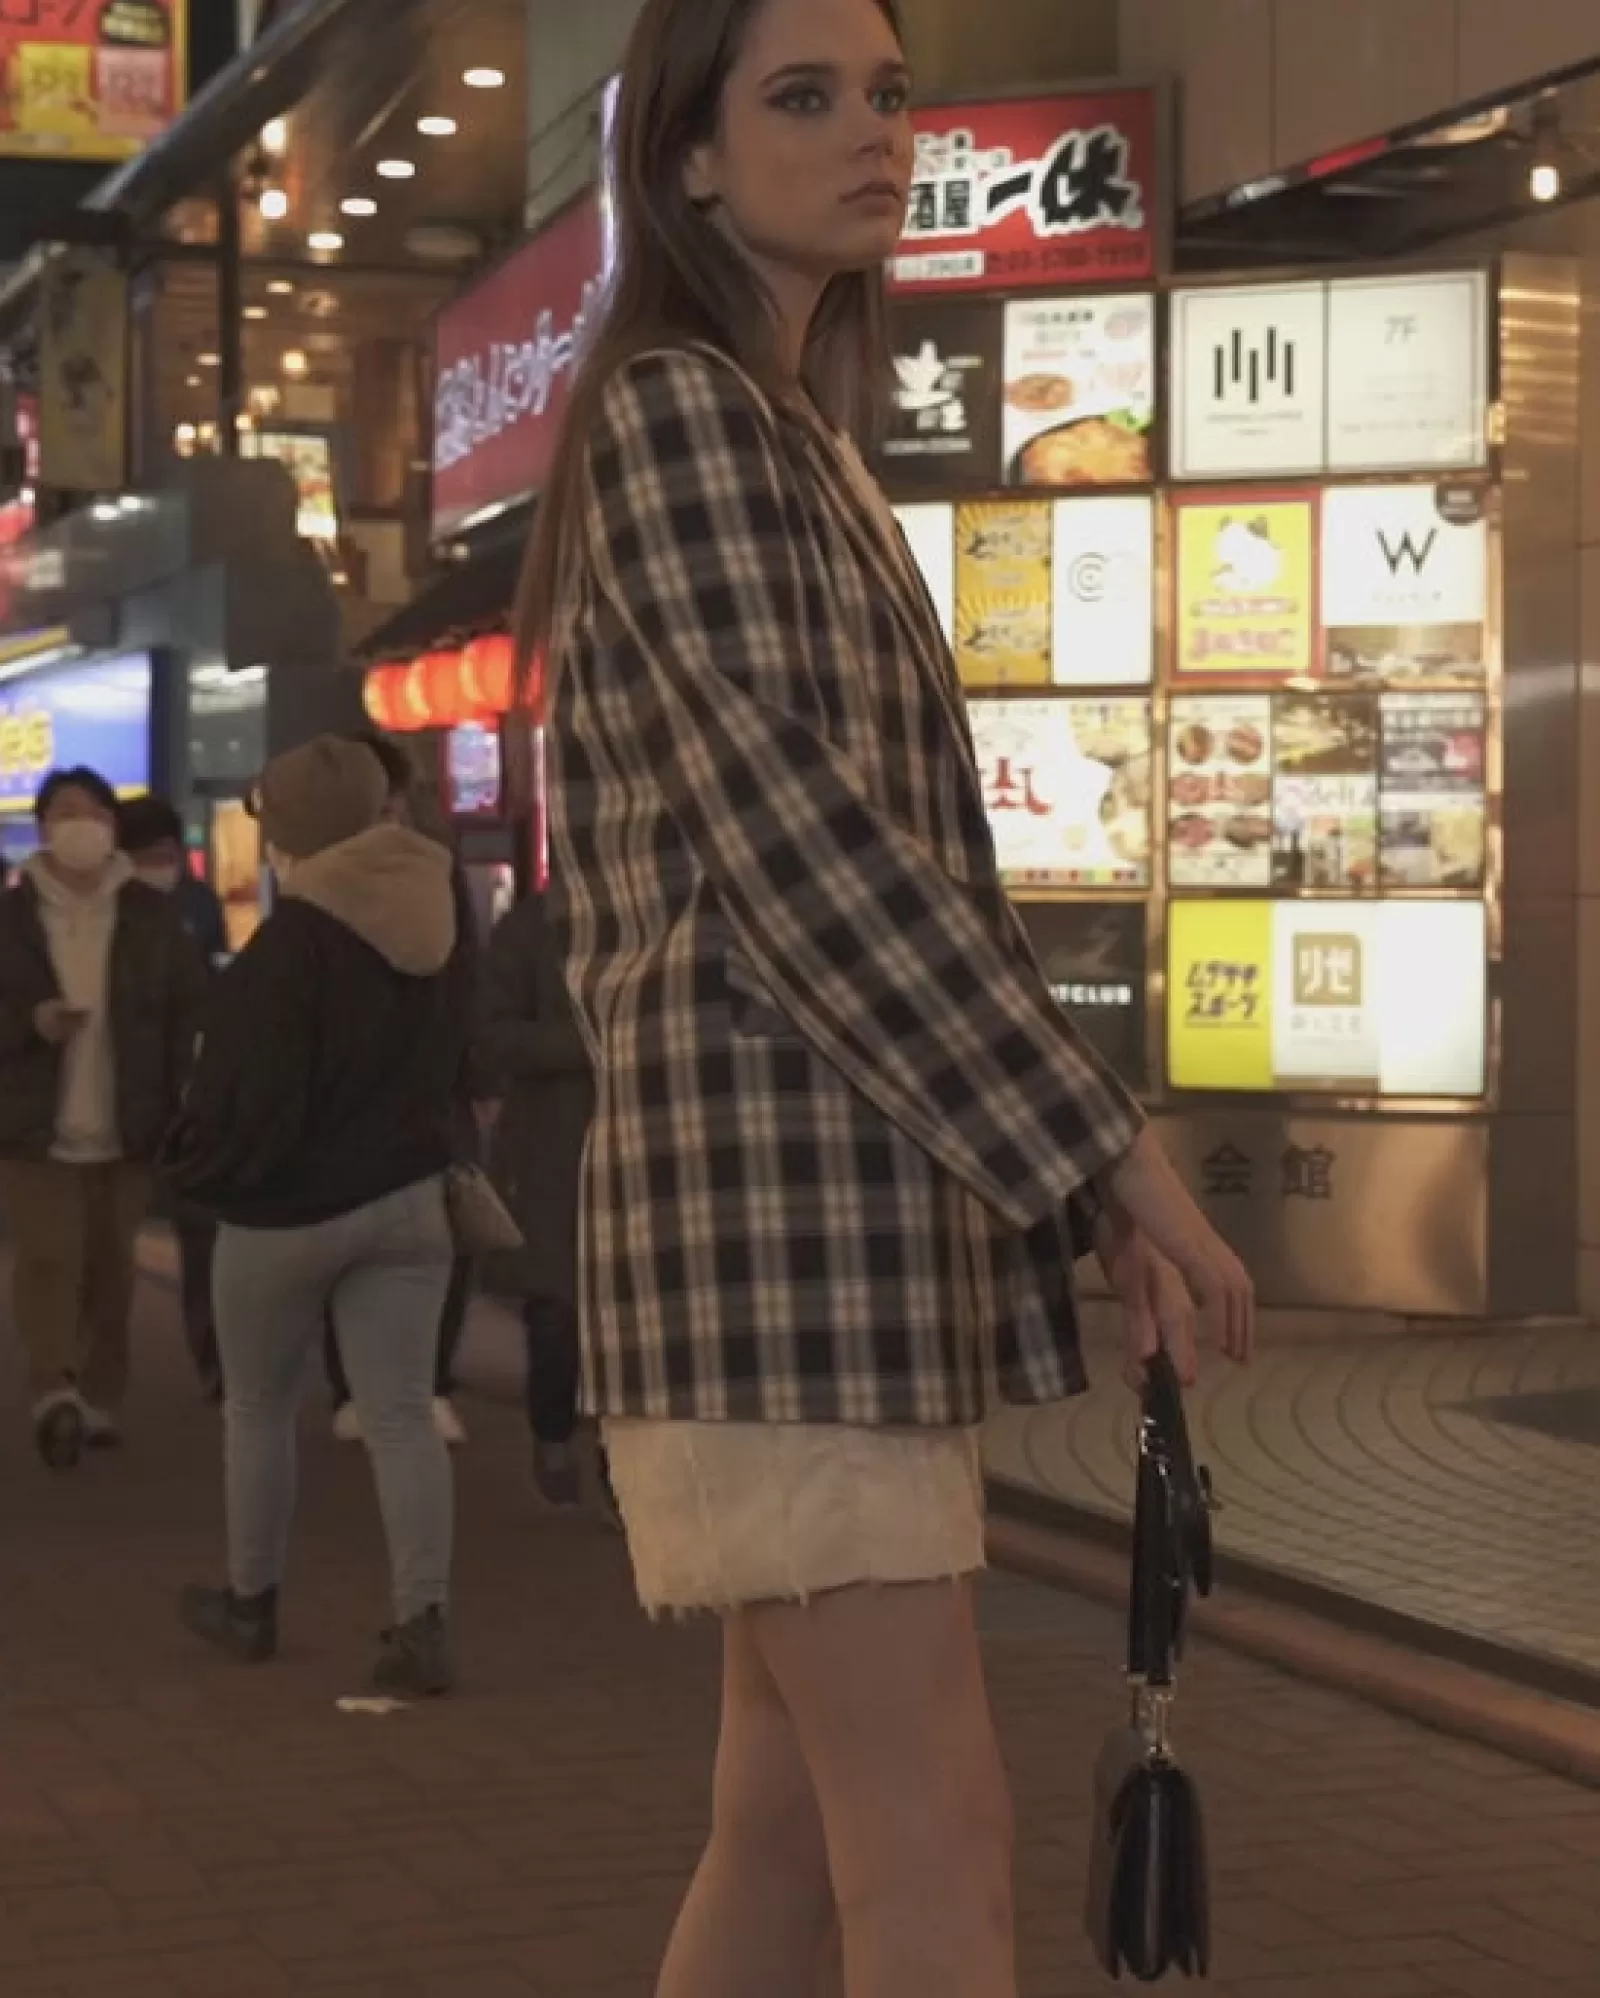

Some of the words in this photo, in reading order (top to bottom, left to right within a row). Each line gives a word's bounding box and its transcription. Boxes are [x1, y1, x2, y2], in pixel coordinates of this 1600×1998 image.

[1376, 527, 1438, 576] W
[1185, 992, 1258, 1020] スポーツ
